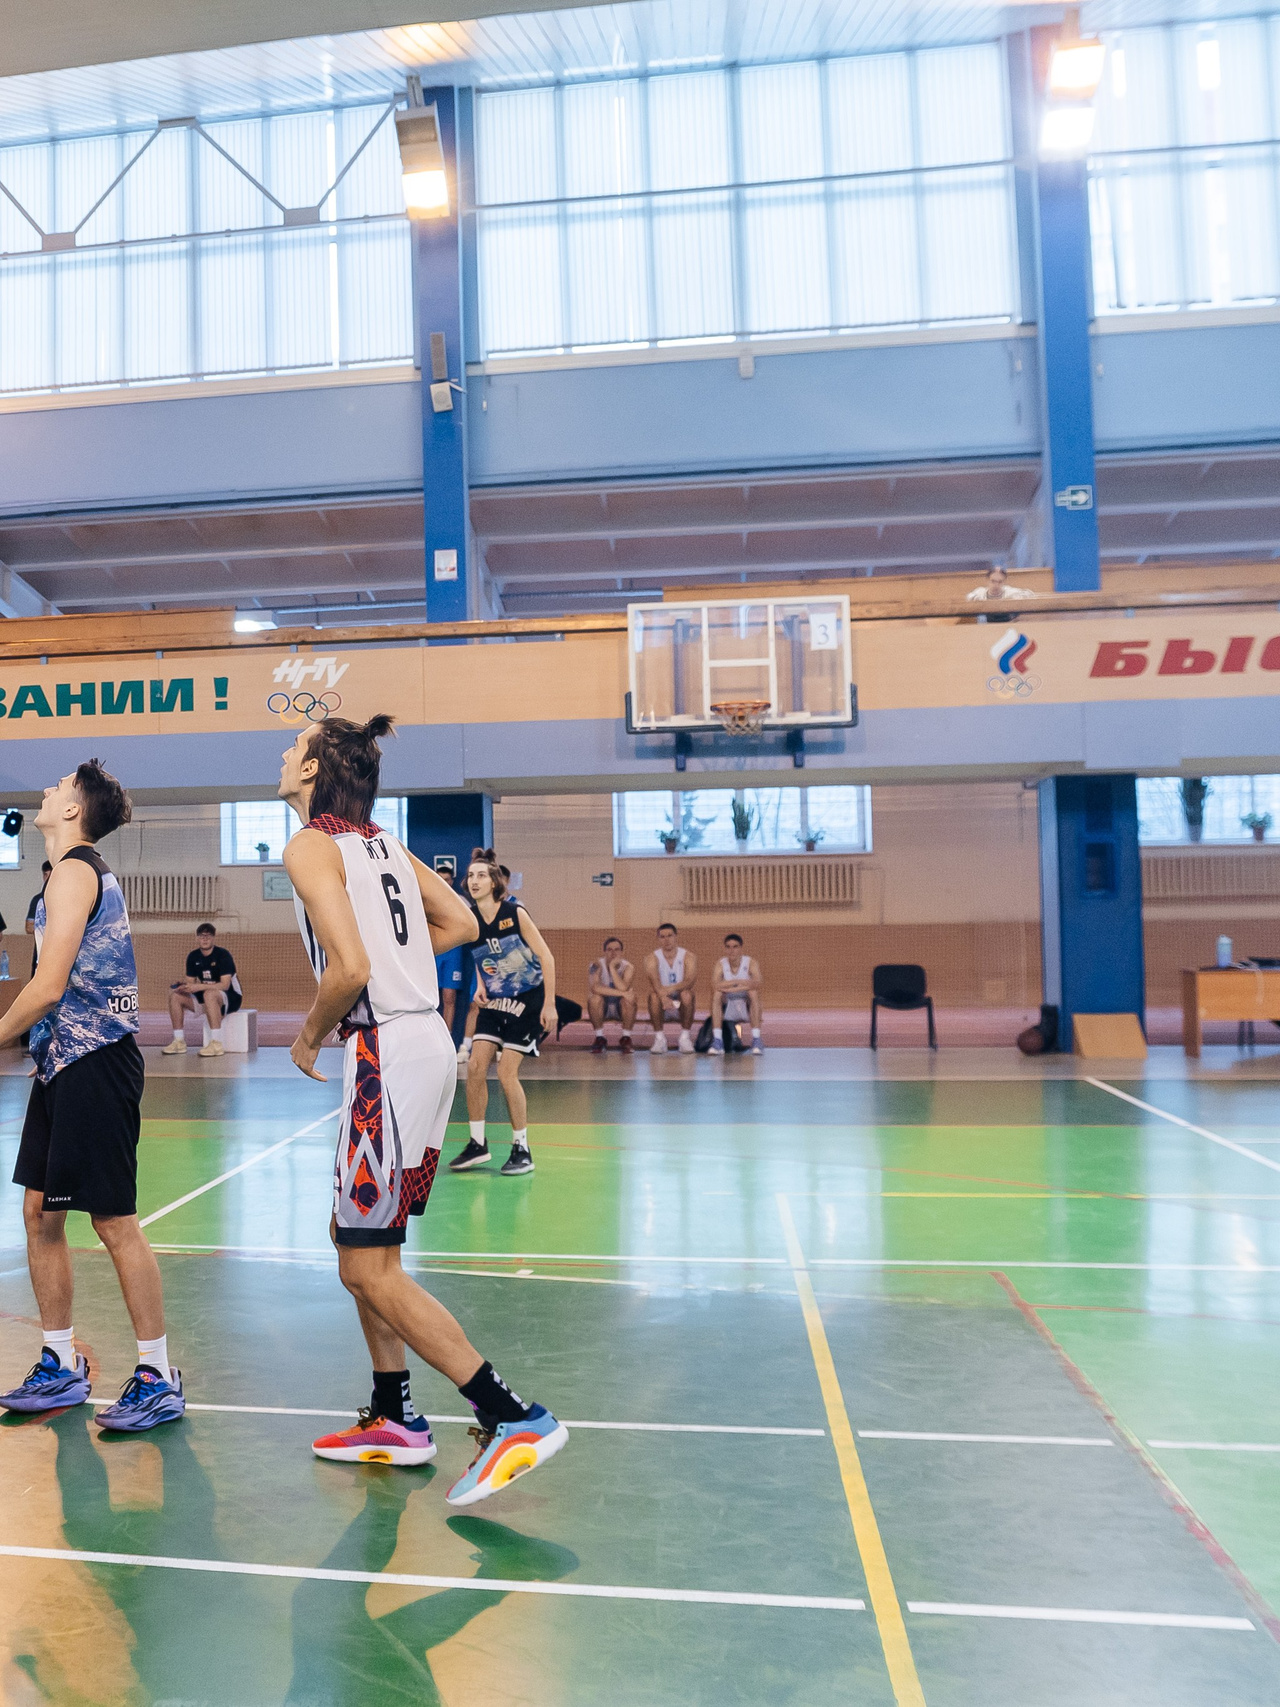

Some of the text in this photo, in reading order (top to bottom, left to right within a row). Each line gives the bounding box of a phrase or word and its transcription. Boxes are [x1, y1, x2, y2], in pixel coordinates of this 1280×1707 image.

[817, 623, 830, 646] 3
[213, 676, 229, 711] !
[380, 872, 409, 947] 6
[485, 937, 503, 954] 18
[107, 994, 139, 1013] НОВ
